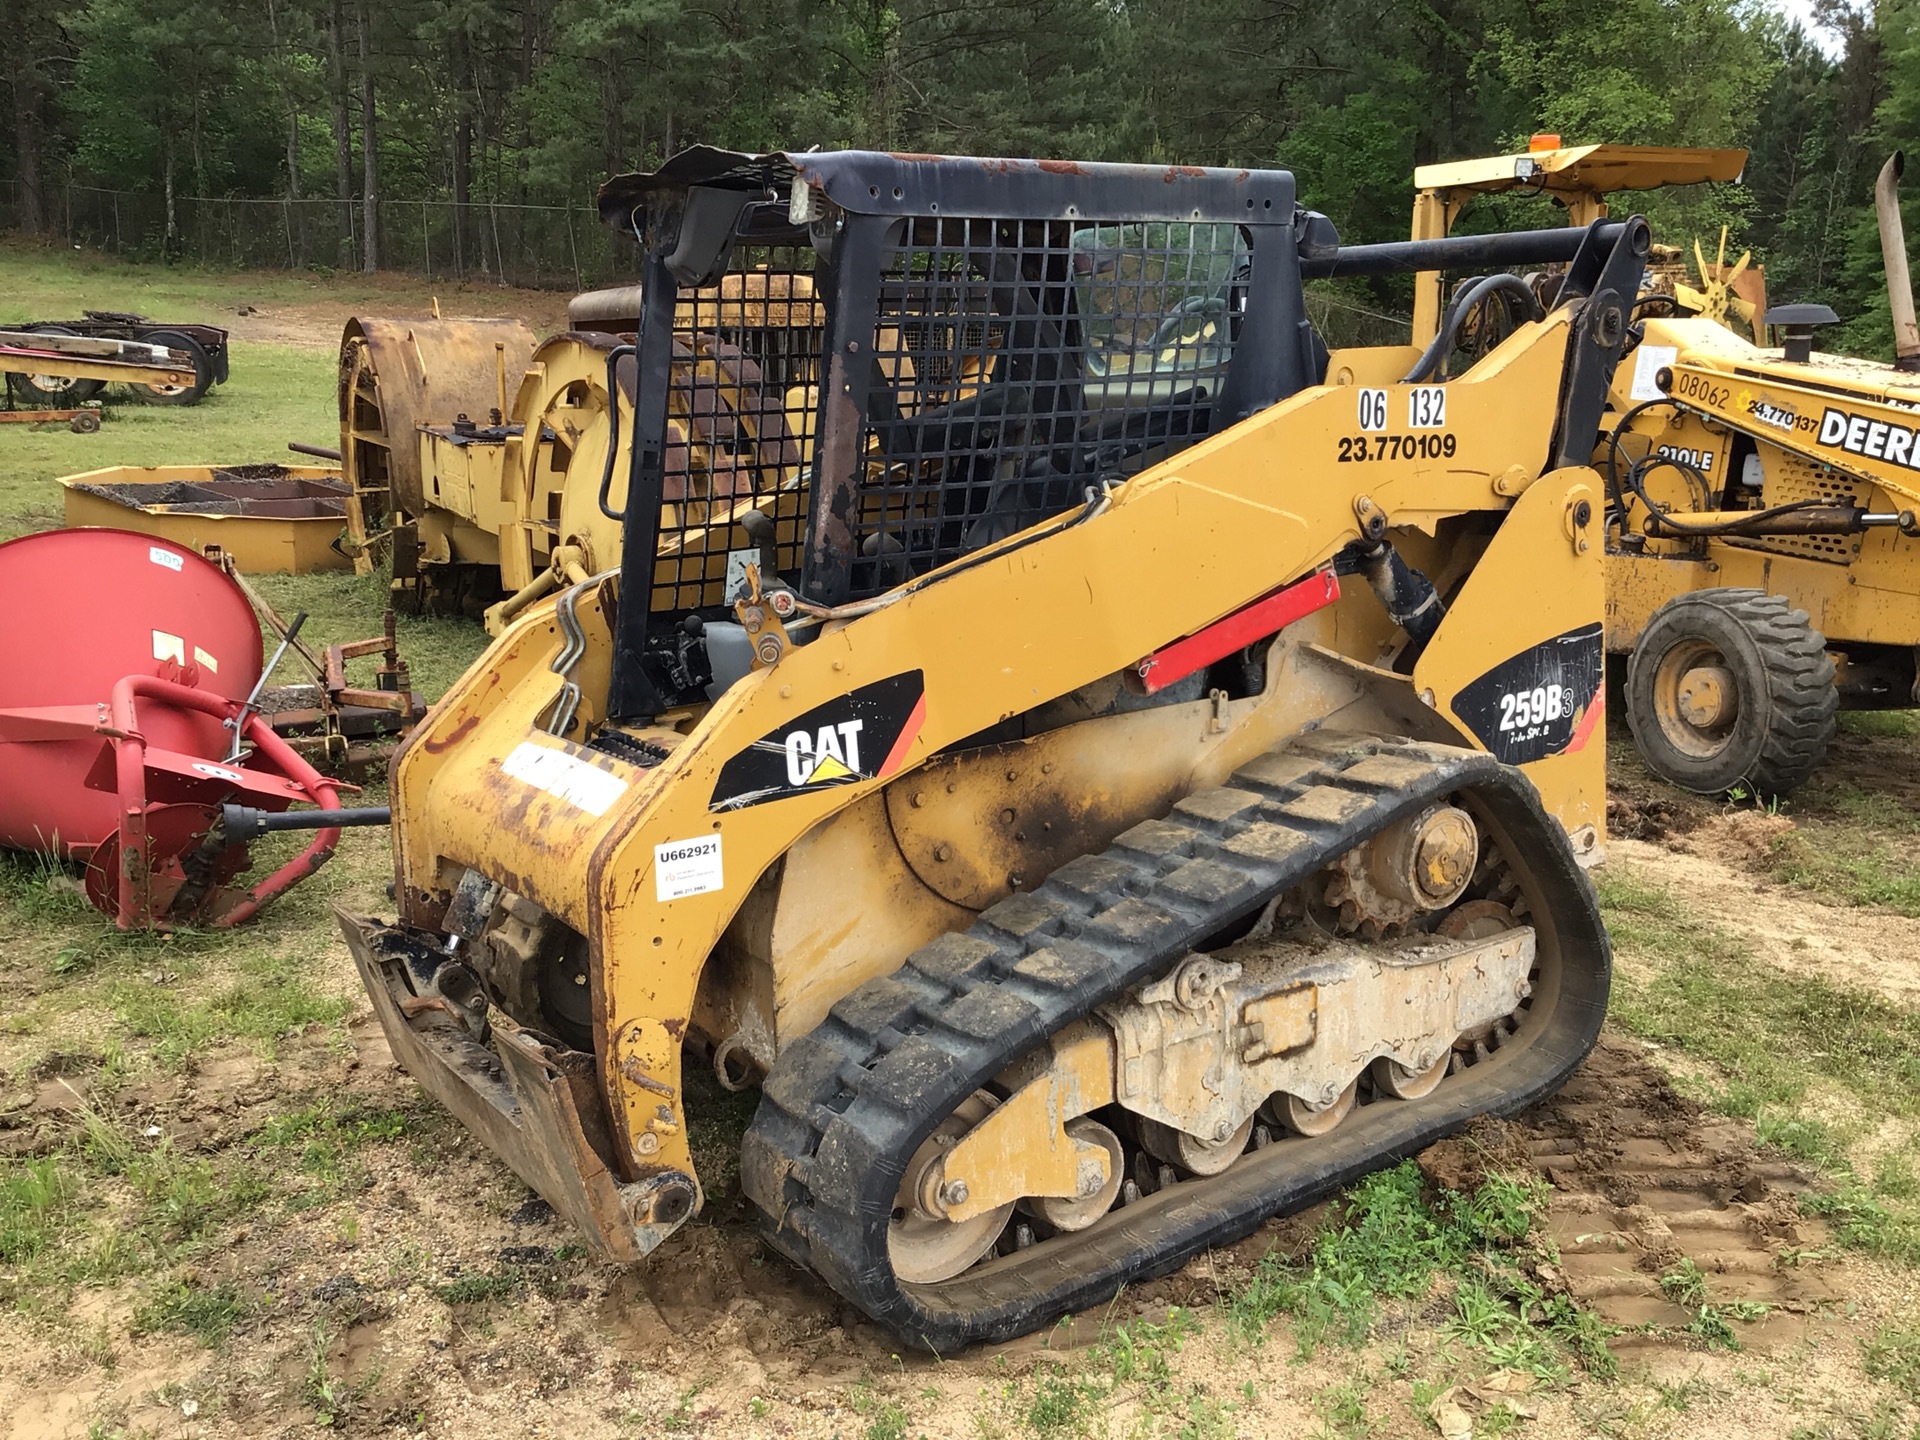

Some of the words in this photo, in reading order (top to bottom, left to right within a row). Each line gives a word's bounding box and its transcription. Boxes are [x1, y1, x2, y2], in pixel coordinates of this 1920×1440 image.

[1359, 390, 1385, 429] 06
[1410, 388, 1444, 426] 132
[1679, 373, 1731, 411] 08062
[1746, 399, 1819, 435] 24.770137
[1337, 433, 1457, 463] 23.770109
[785, 718, 863, 787] CAT
[660, 842, 717, 863] U662921
